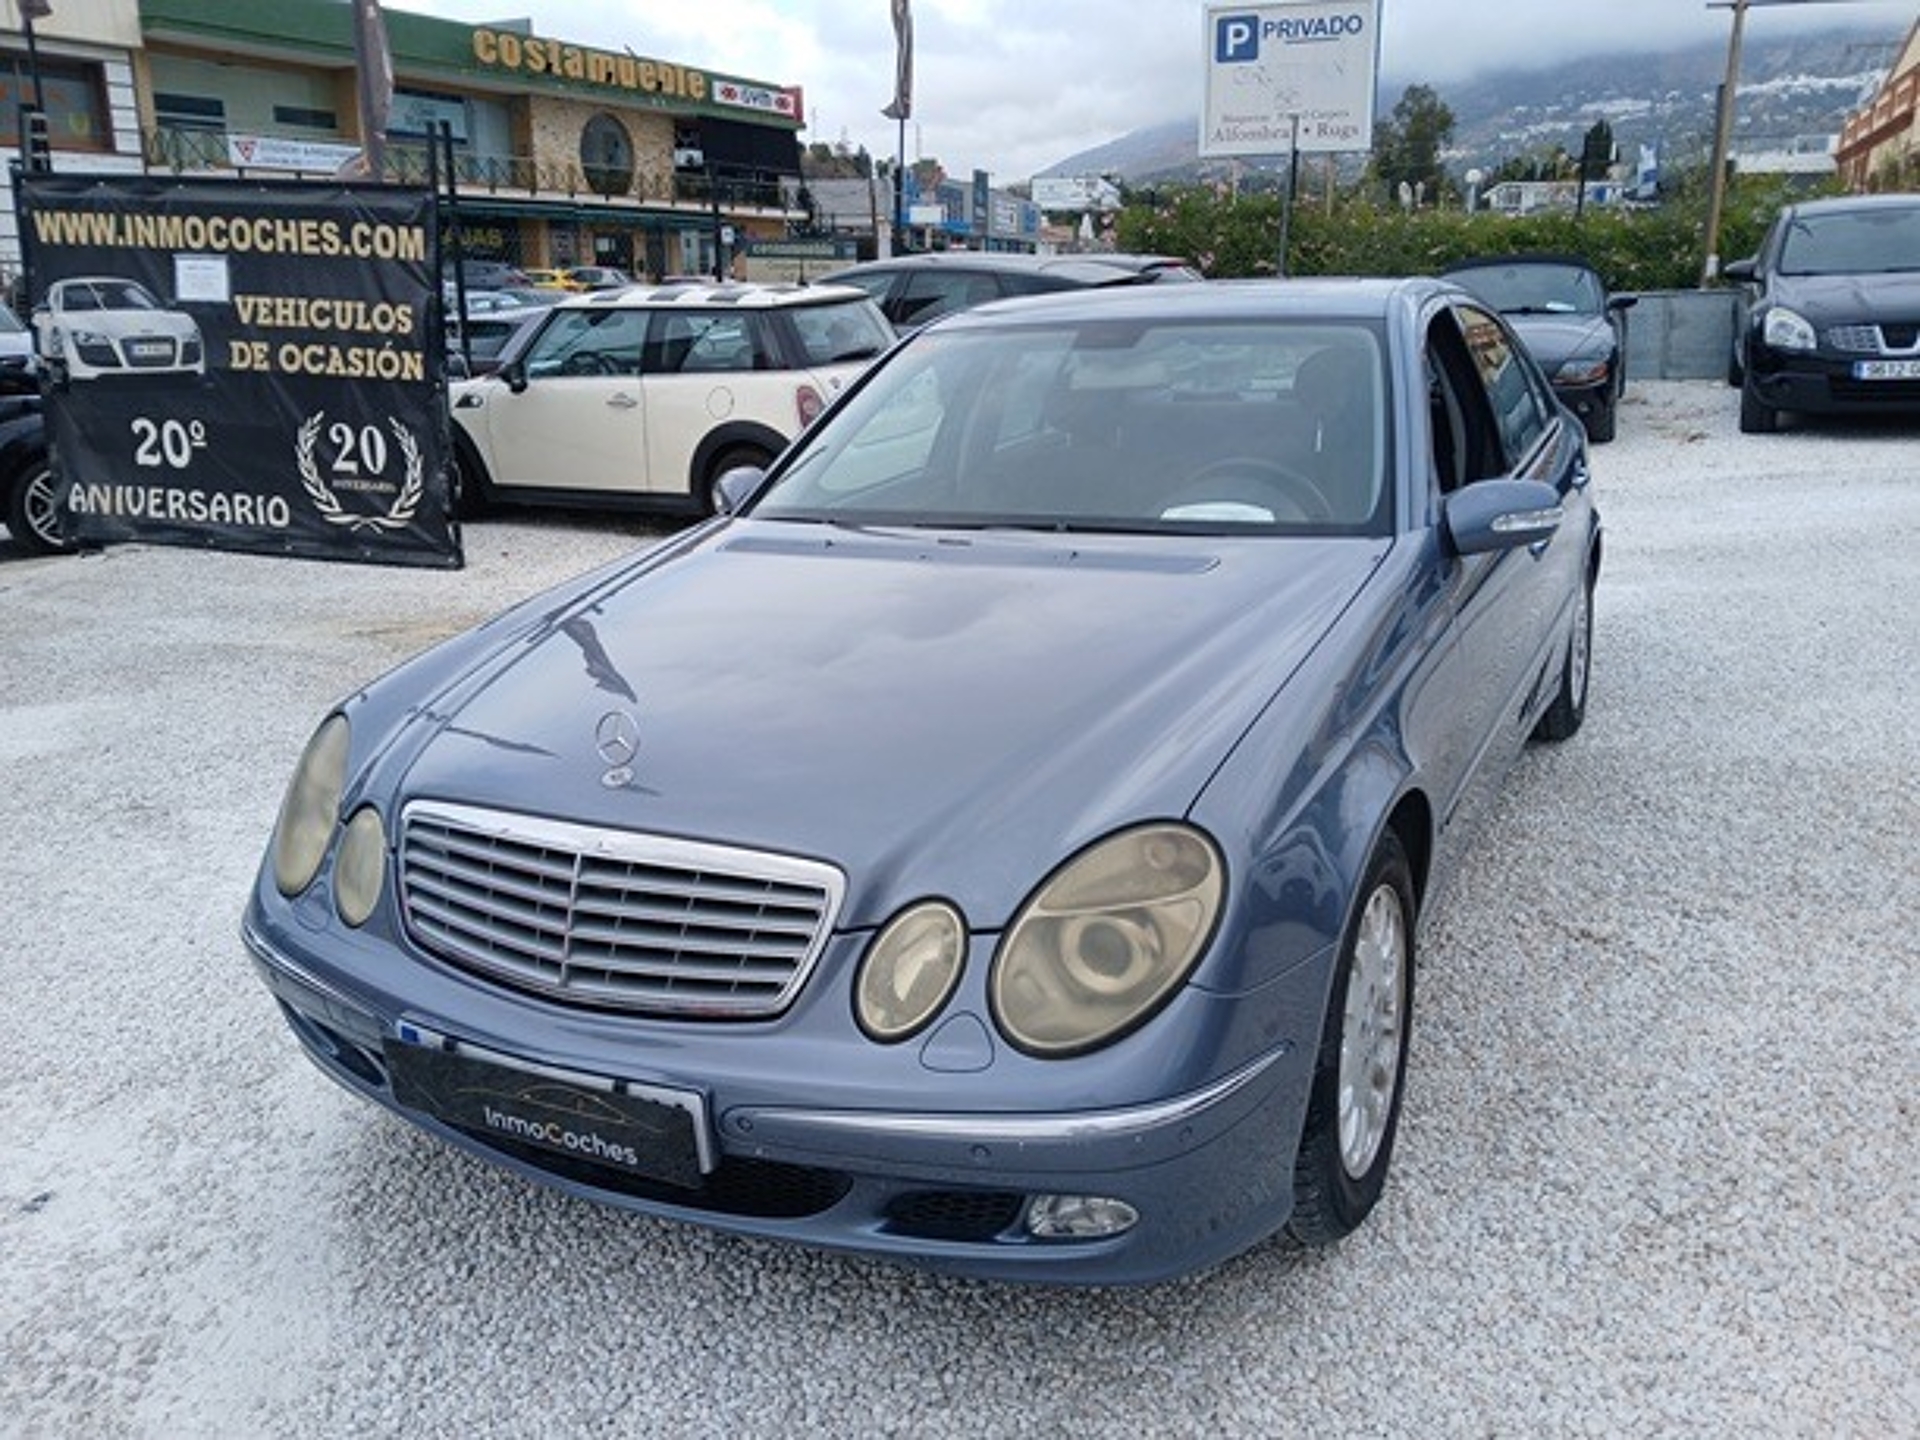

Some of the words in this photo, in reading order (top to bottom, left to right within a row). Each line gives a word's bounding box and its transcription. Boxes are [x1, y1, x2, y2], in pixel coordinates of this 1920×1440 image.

[1263, 14, 1363, 38] PRIVADO
[1211, 124, 1299, 142] Alfombra
[1317, 121, 1360, 140] Rugs
[33, 210, 426, 261] WWW.INMOCOCHES.COM
[234, 295, 413, 333] VEHICULOS
[229, 341, 270, 370] DE
[279, 341, 424, 380] OCASIÓN
[331, 422, 387, 475] 20
[68, 483, 290, 528] ANIVERSARIO
[484, 1106, 638, 1166] InmoCoches
